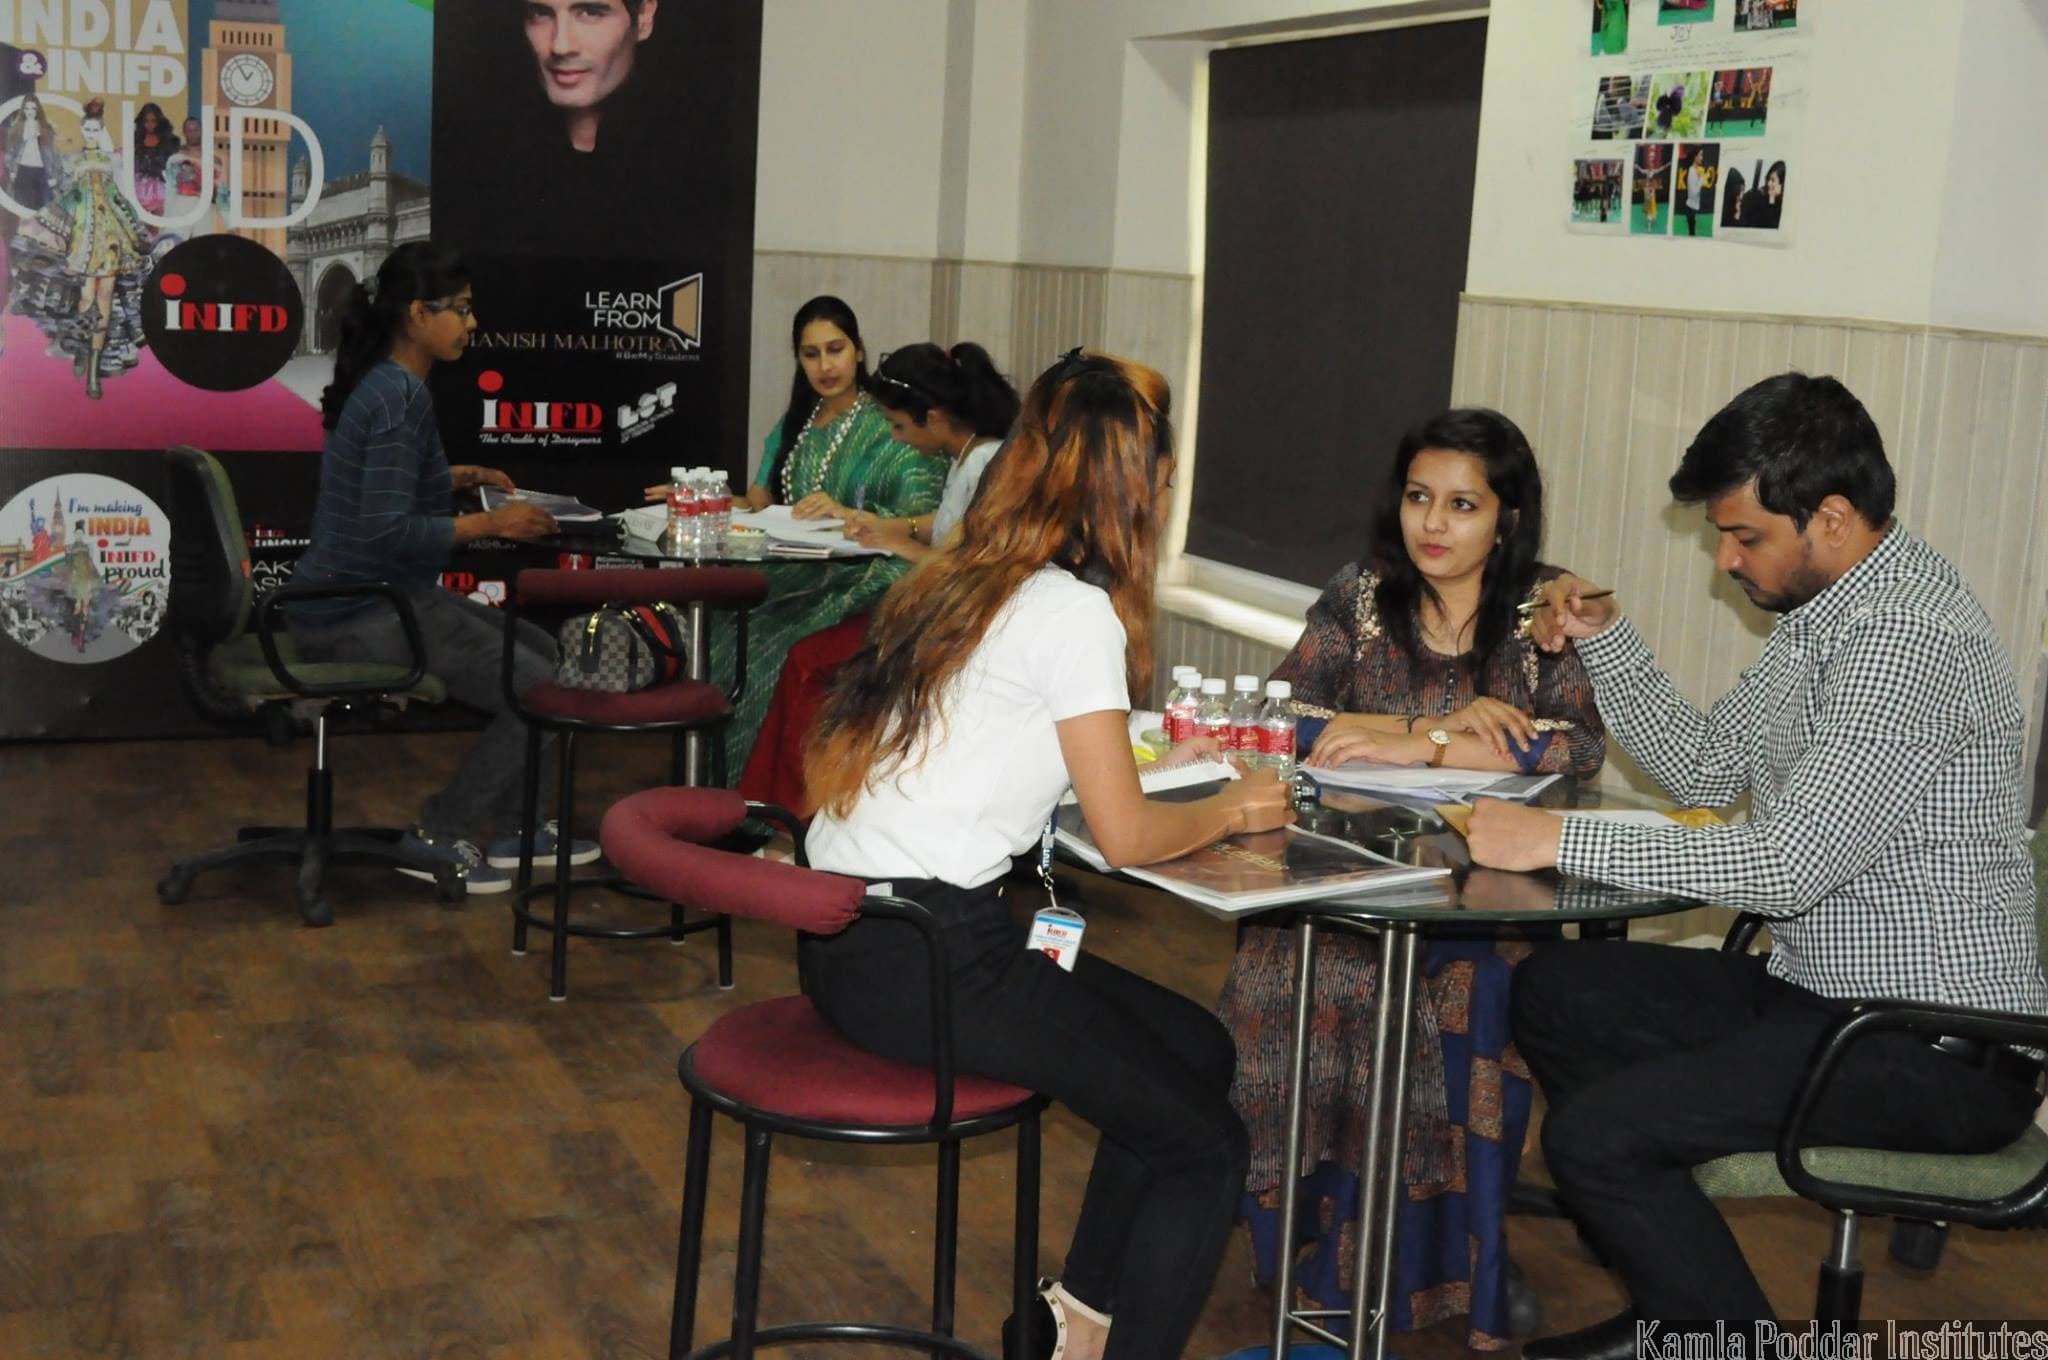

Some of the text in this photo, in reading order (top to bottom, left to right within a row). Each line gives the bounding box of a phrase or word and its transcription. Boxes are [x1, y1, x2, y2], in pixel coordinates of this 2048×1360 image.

[0, 0, 184, 53] INDIA
[1670, 24, 1694, 41] JOY
[47, 49, 187, 97] INIFD
[586, 291, 661, 309] LEARN
[594, 310, 661, 329] FROM
[553, 334, 678, 352] MALHOTRA
[480, 433, 602, 447] The Cradle of Designers
[93, 499, 144, 517] making
[88, 517, 152, 537] INDIA
[104, 558, 167, 584] proud
